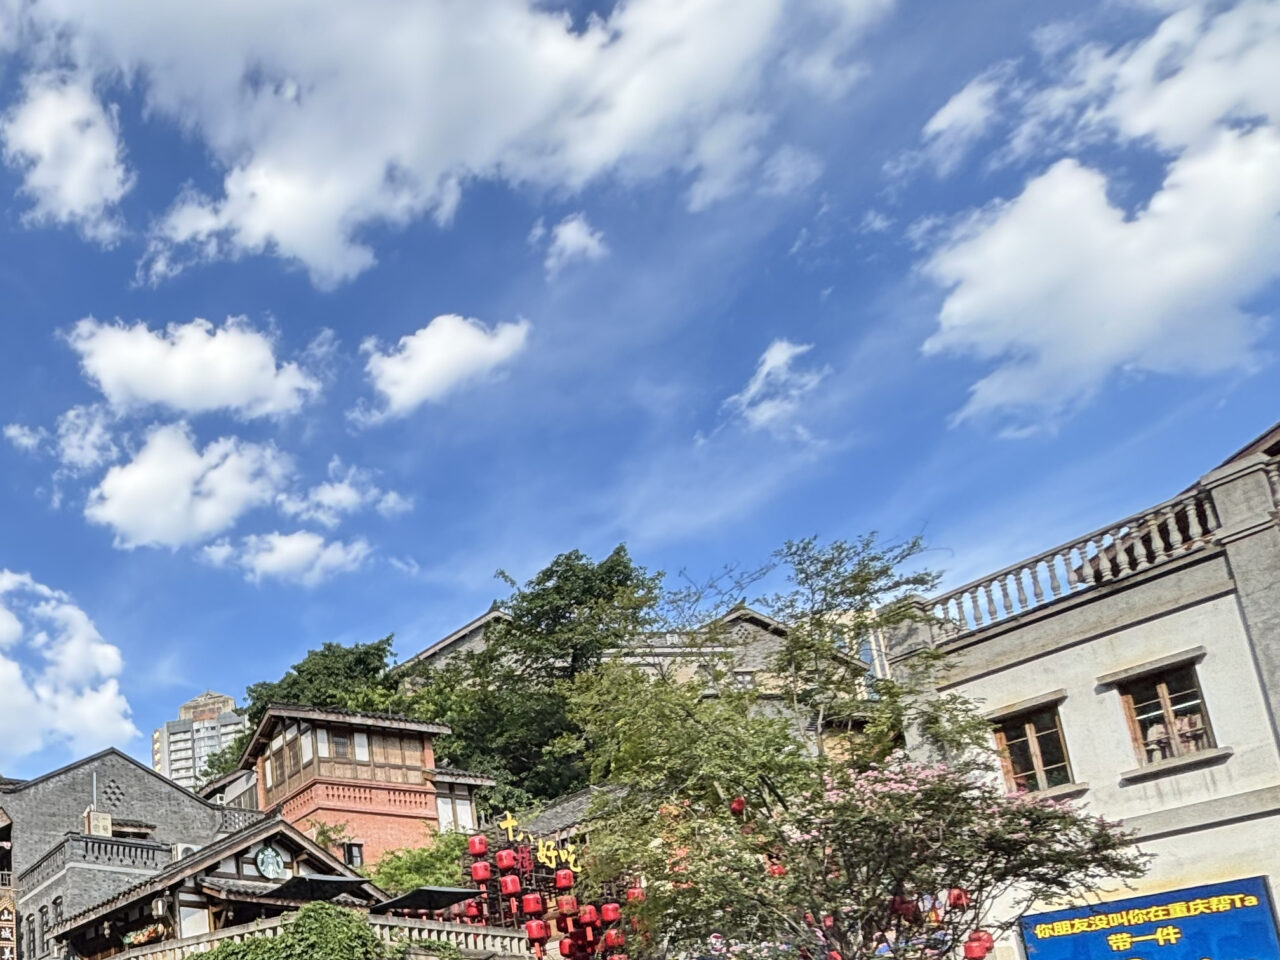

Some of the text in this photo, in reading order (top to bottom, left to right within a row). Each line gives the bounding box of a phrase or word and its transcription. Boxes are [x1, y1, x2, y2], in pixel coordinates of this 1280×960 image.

[1035, 893, 1259, 939] 你朋友没叫你在重庆帮Ta
[1107, 926, 1182, 951] 带一件
